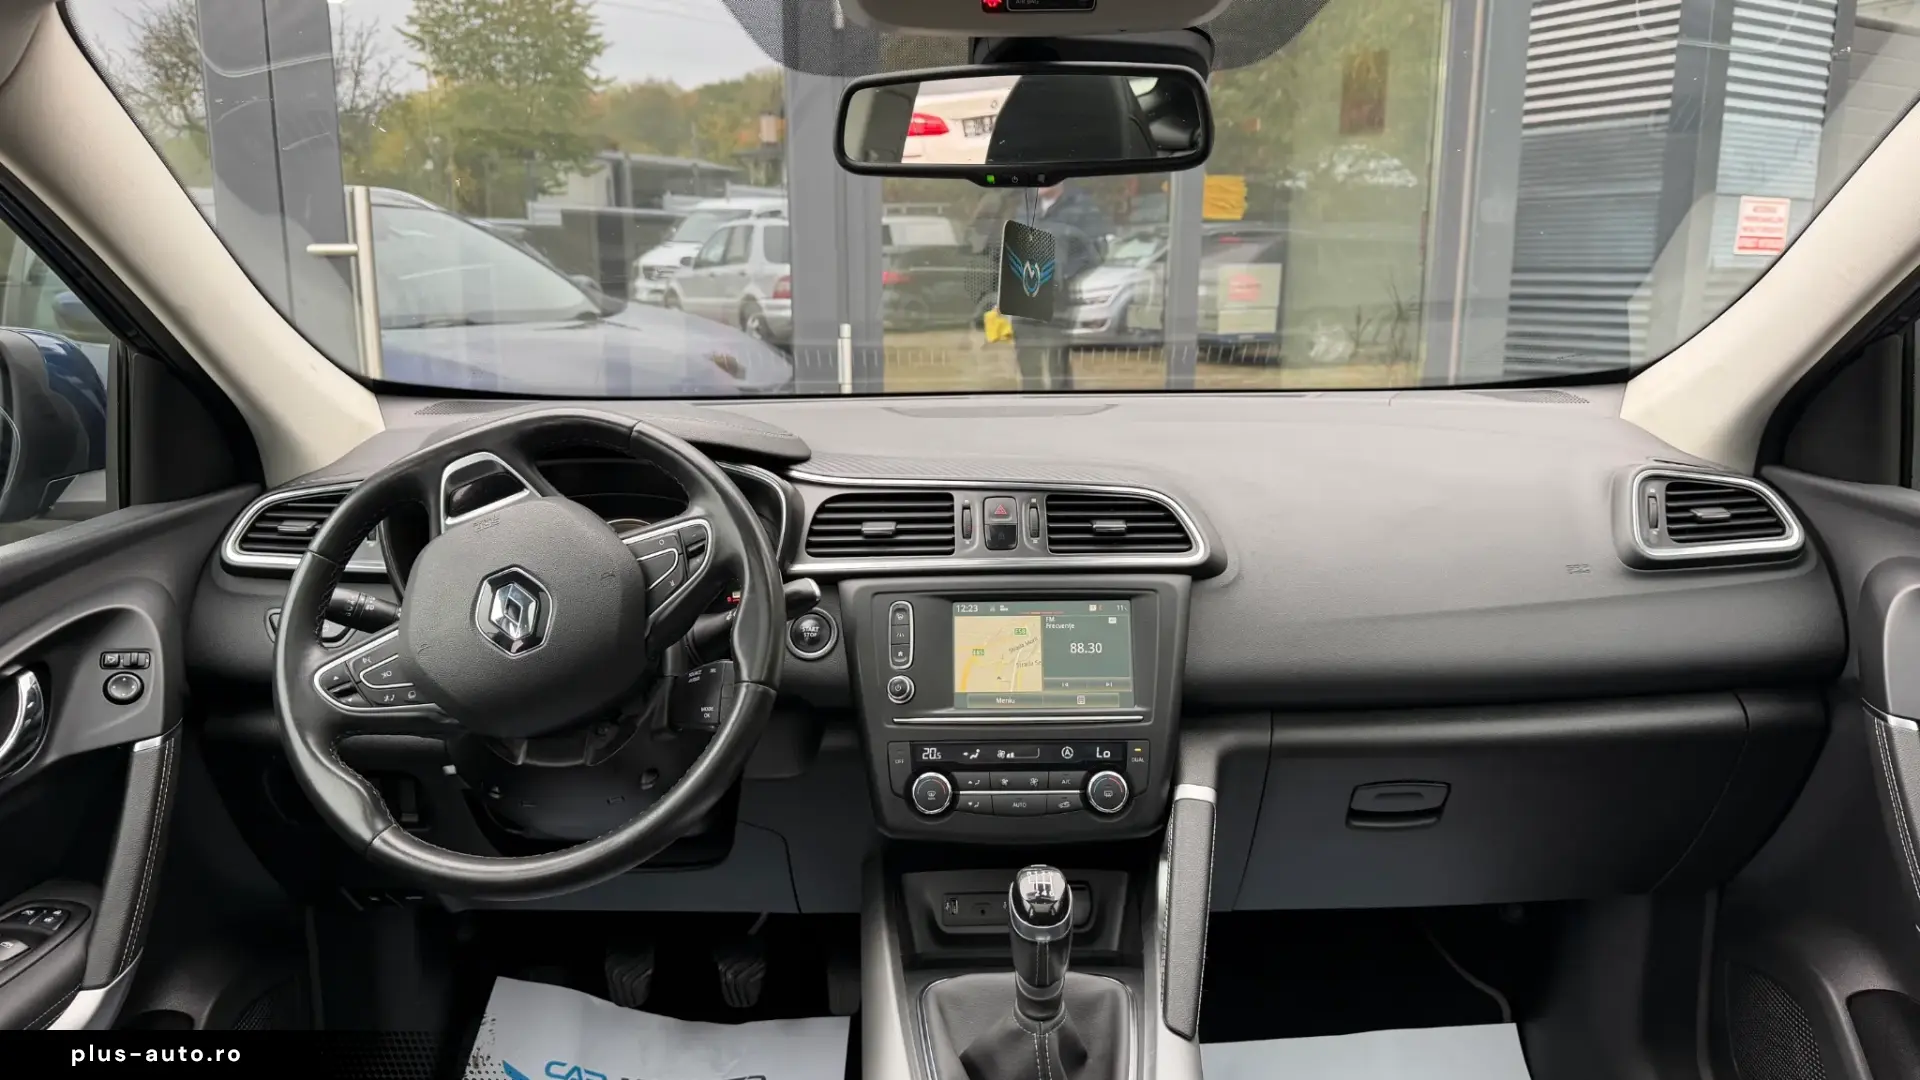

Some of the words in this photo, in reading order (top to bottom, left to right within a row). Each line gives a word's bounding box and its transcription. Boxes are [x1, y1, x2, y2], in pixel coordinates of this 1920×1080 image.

[955, 604, 979, 613] 12:23
[1070, 642, 1103, 654] 88.30
[1096, 746, 1111, 758] Lo
